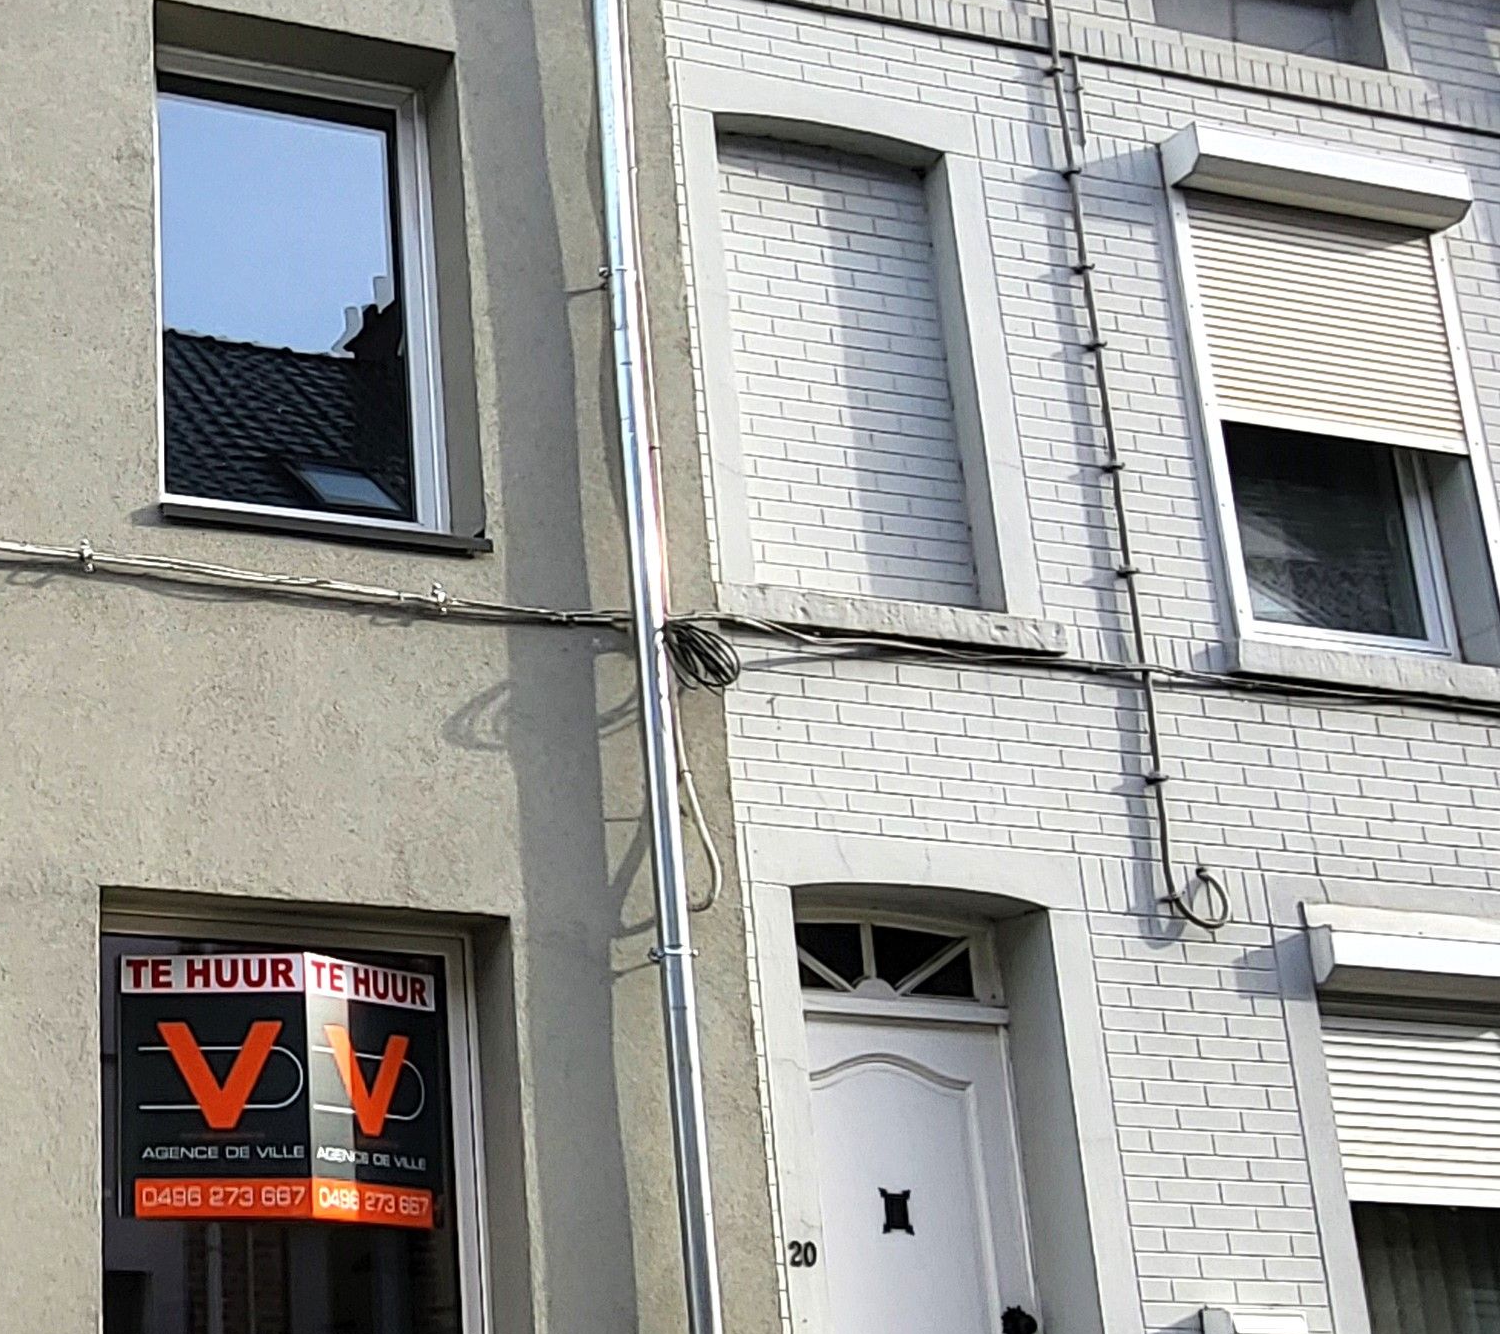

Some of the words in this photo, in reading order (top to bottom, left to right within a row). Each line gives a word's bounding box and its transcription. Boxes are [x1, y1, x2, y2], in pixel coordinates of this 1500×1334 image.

[126, 958, 173, 989] TE
[186, 958, 296, 988] HUUR
[311, 960, 345, 993] TE
[353, 967, 428, 1007] HUUR
[141, 1146, 219, 1160] AGENCE
[225, 1146, 251, 1159] DE
[256, 1145, 306, 1159] VILLE
[316, 1146, 370, 1166] AGENCE
[372, 1153, 392, 1168] DE
[393, 1154, 427, 1172] VILLE
[208, 1186, 255, 1207] 273
[261, 1185, 306, 1207] 667
[364, 1192, 396, 1214] 273
[787, 1240, 818, 1268] 20
